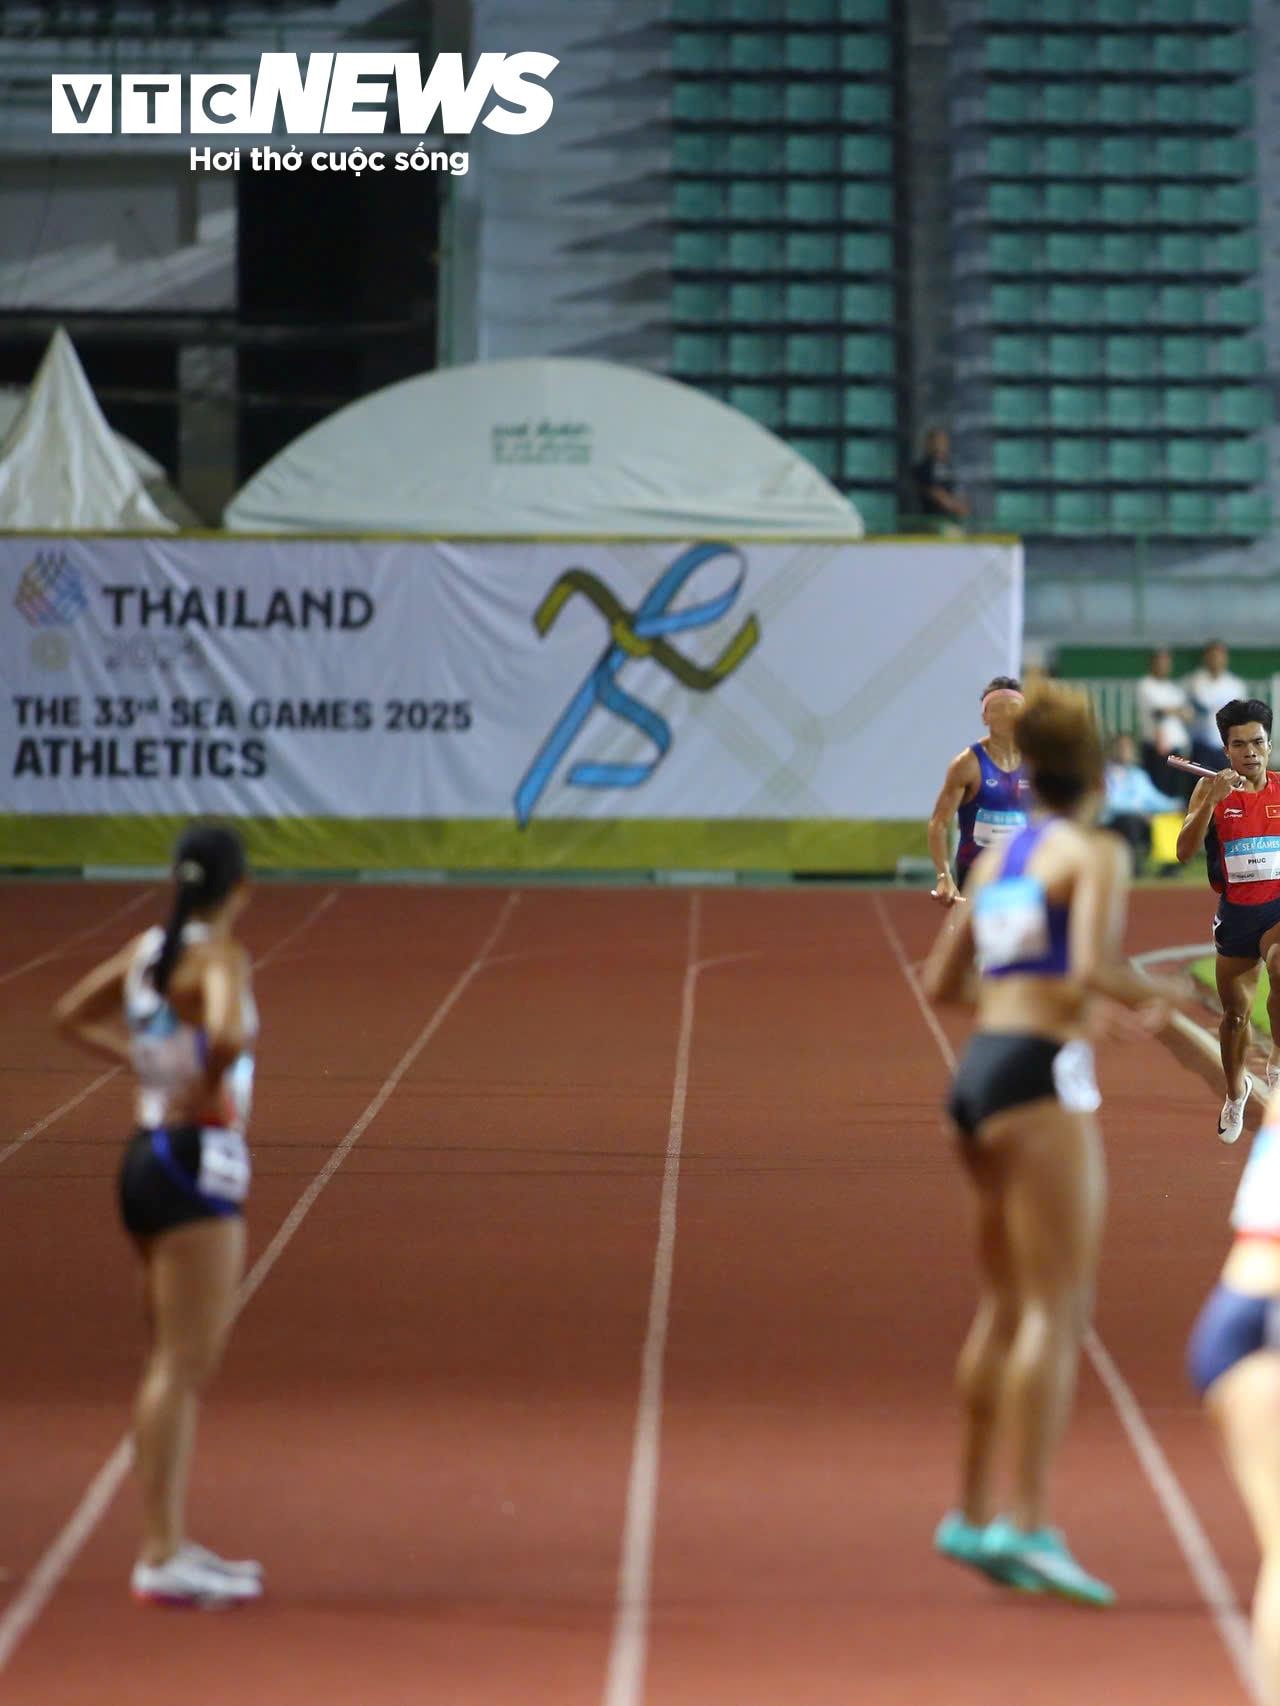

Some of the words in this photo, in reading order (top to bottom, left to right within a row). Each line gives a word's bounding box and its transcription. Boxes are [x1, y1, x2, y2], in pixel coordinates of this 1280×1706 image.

[102, 585, 375, 631] THAILAND
[13, 696, 81, 727] THE
[94, 697, 160, 728] 33rd
[171, 698, 238, 728] SEA
[250, 699, 372, 731] GAMES
[386, 701, 472, 732] 2025
[13, 738, 267, 778] ATHLETICS
